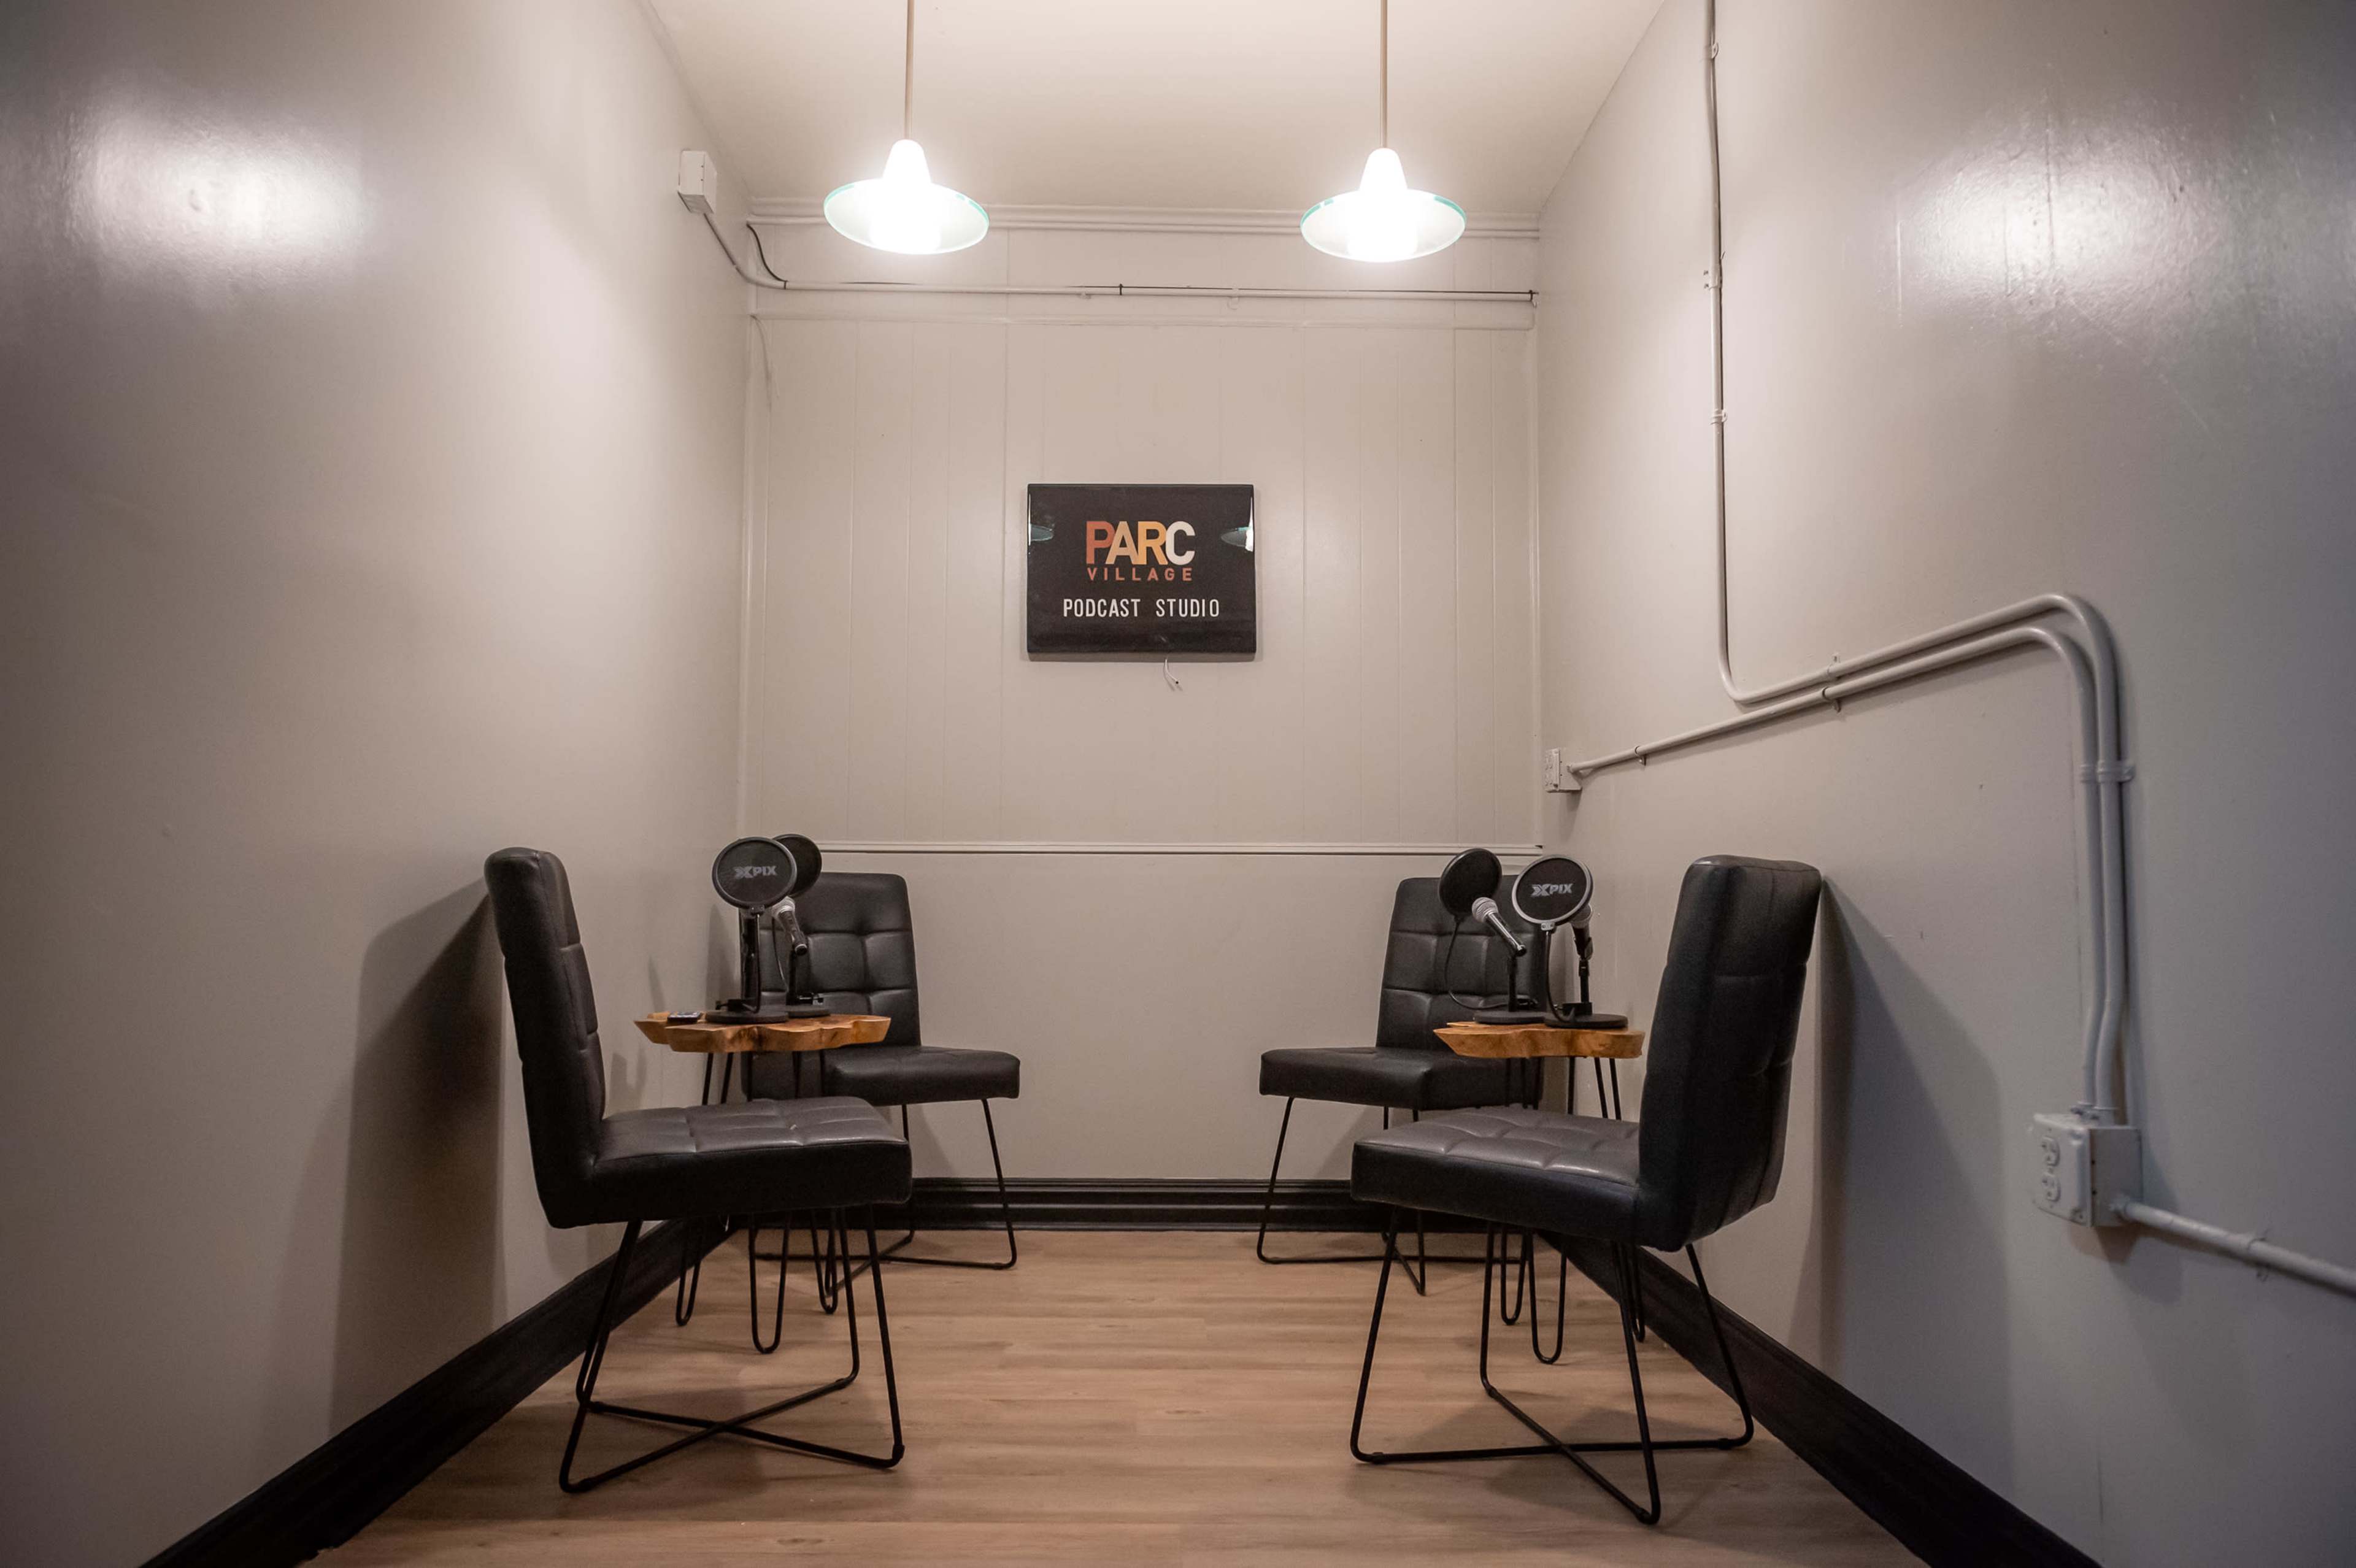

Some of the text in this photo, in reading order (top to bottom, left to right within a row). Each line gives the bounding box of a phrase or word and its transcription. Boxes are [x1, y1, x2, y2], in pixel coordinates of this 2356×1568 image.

[1086, 521, 1195, 565] PARC
[1087, 567, 1192, 581] VILLAGE
[1063, 598, 1220, 618] PODCAST STUDIO
